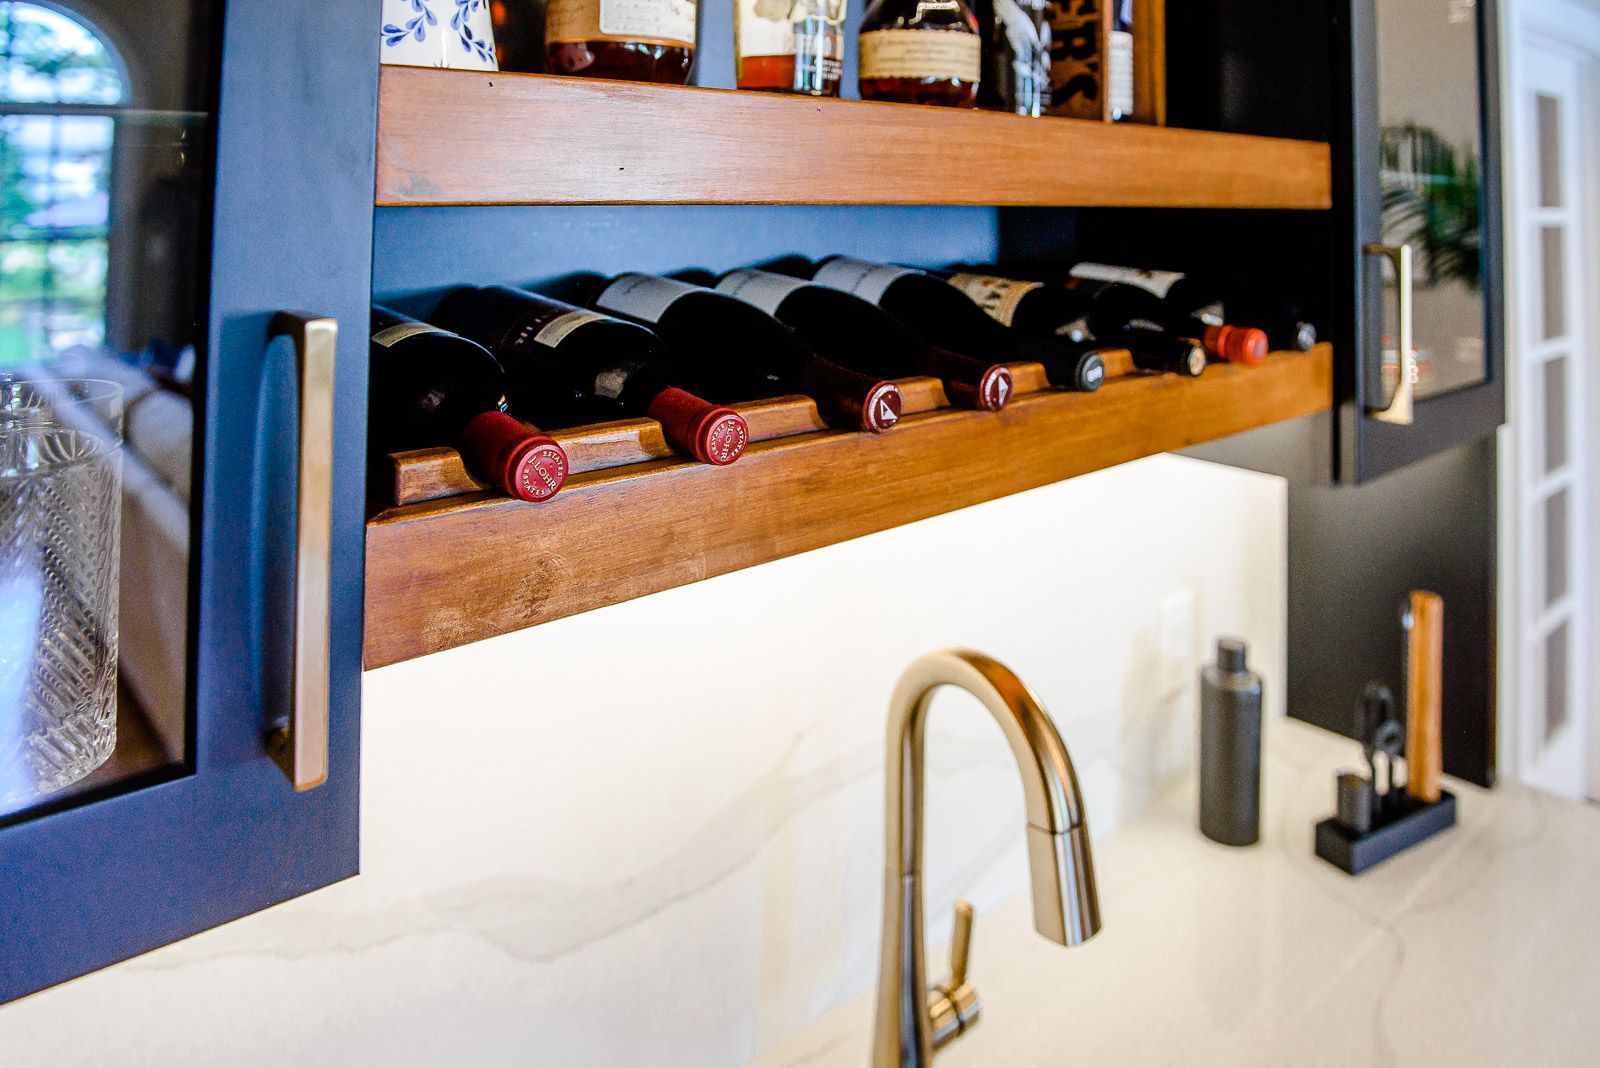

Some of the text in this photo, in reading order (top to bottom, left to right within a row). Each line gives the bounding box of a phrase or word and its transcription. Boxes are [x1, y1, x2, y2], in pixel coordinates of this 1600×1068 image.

[721, 428, 734, 460] LOHR
[527, 456, 557, 492] J. LOHR
[542, 450, 564, 477] ESTATES
[522, 468, 545, 496] ESTATES
